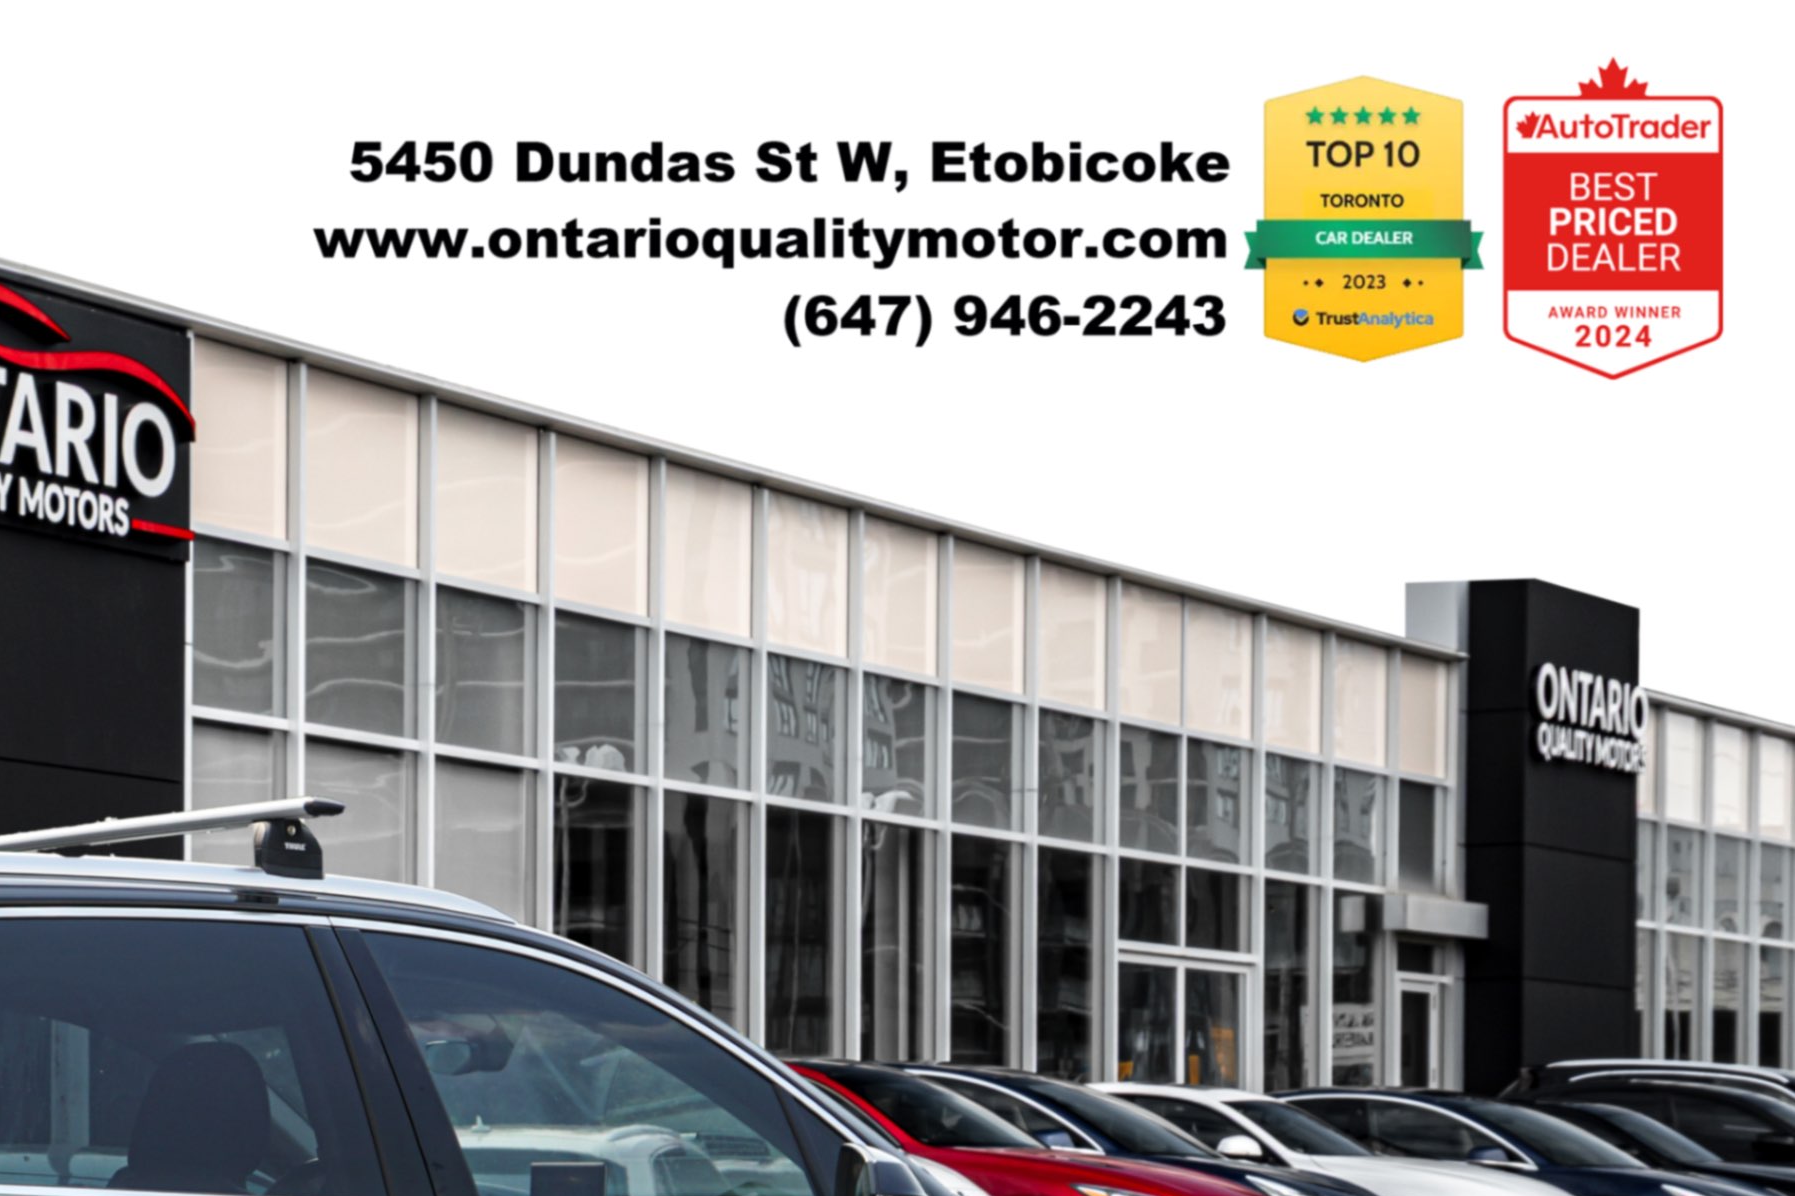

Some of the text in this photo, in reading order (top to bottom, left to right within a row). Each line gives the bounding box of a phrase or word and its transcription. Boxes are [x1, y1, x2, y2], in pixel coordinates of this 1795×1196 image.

[19, 476, 130, 537] MOTORS
[1536, 662, 1649, 740] ONTARIO
[1537, 722, 1594, 762] QUALITY
